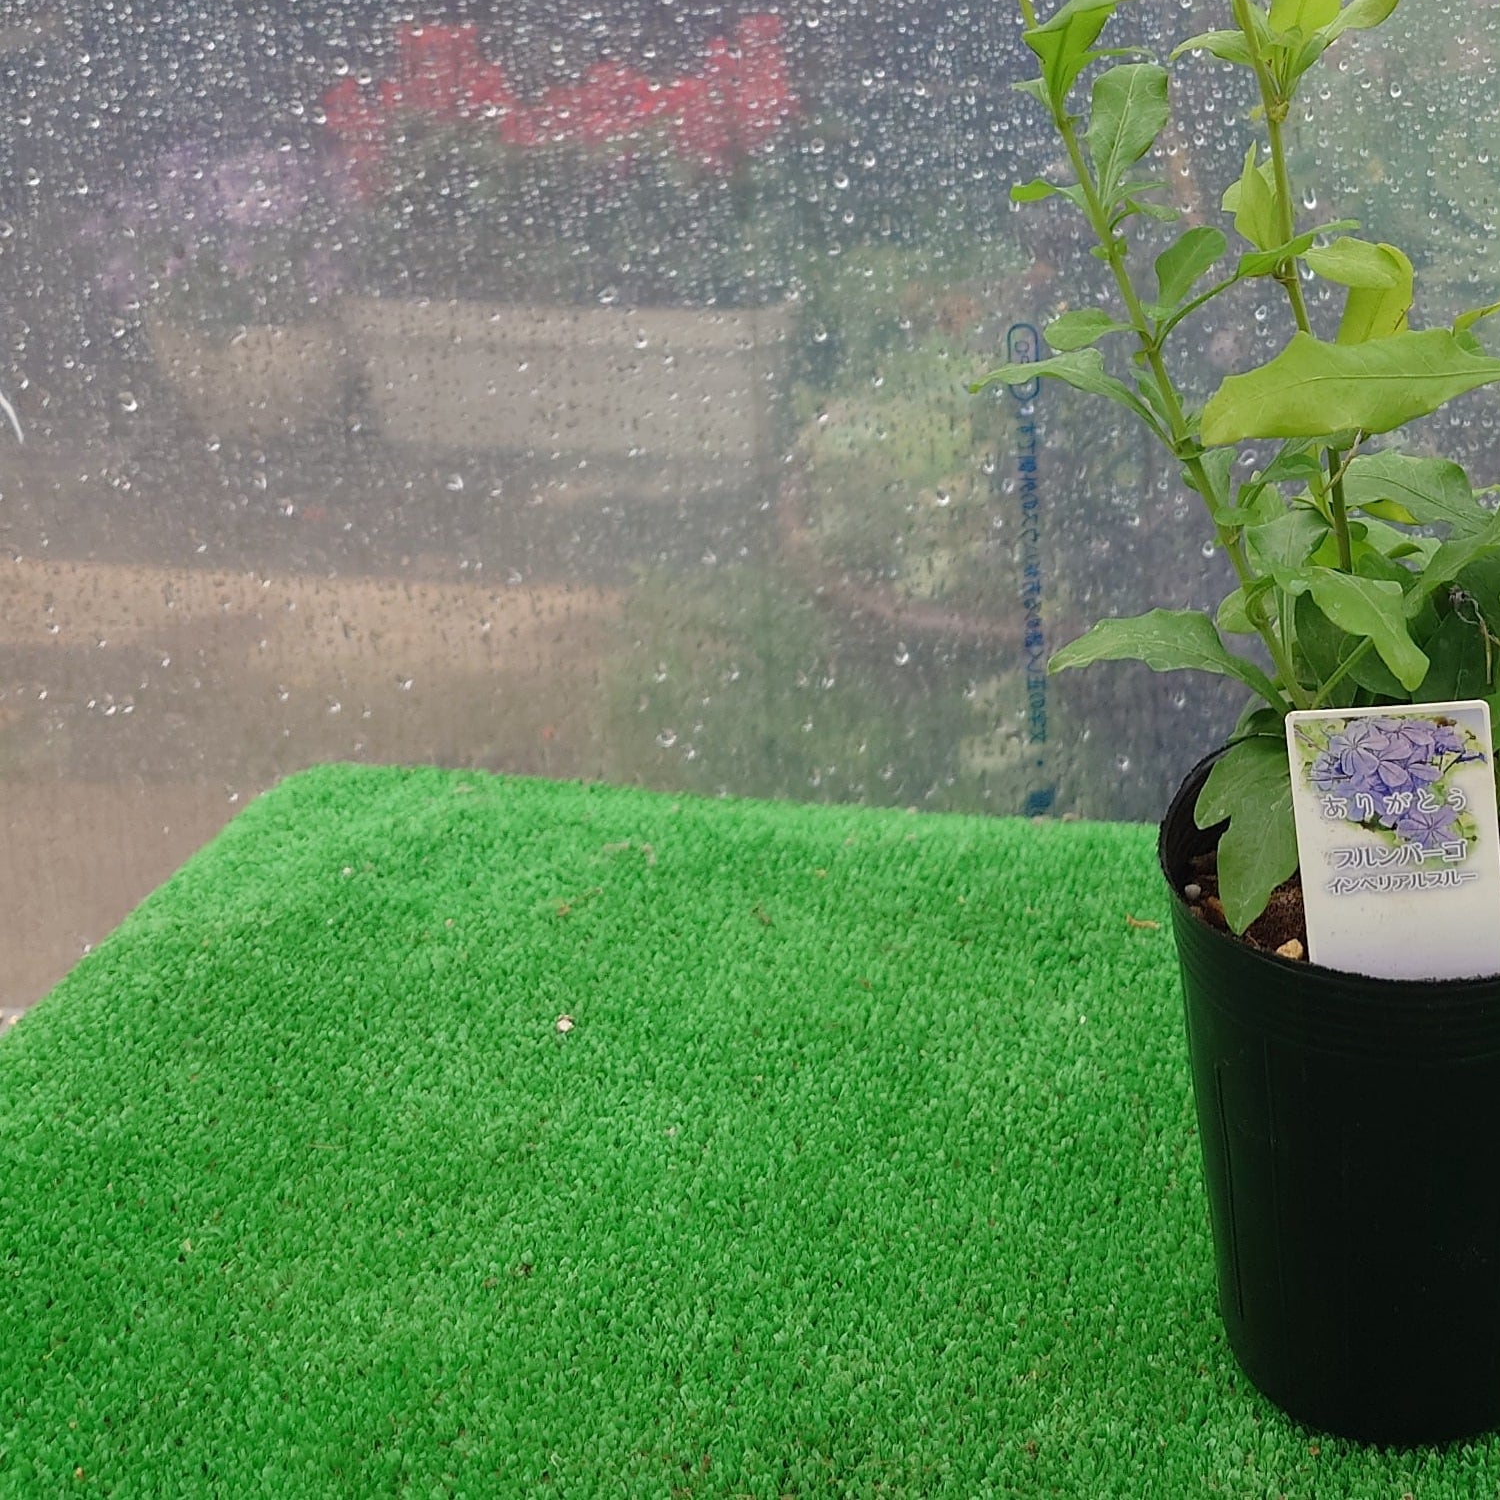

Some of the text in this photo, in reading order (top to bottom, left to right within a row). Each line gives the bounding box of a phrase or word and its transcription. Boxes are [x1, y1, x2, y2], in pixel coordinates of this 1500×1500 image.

[1321, 788, 1467, 820] ありがとう
